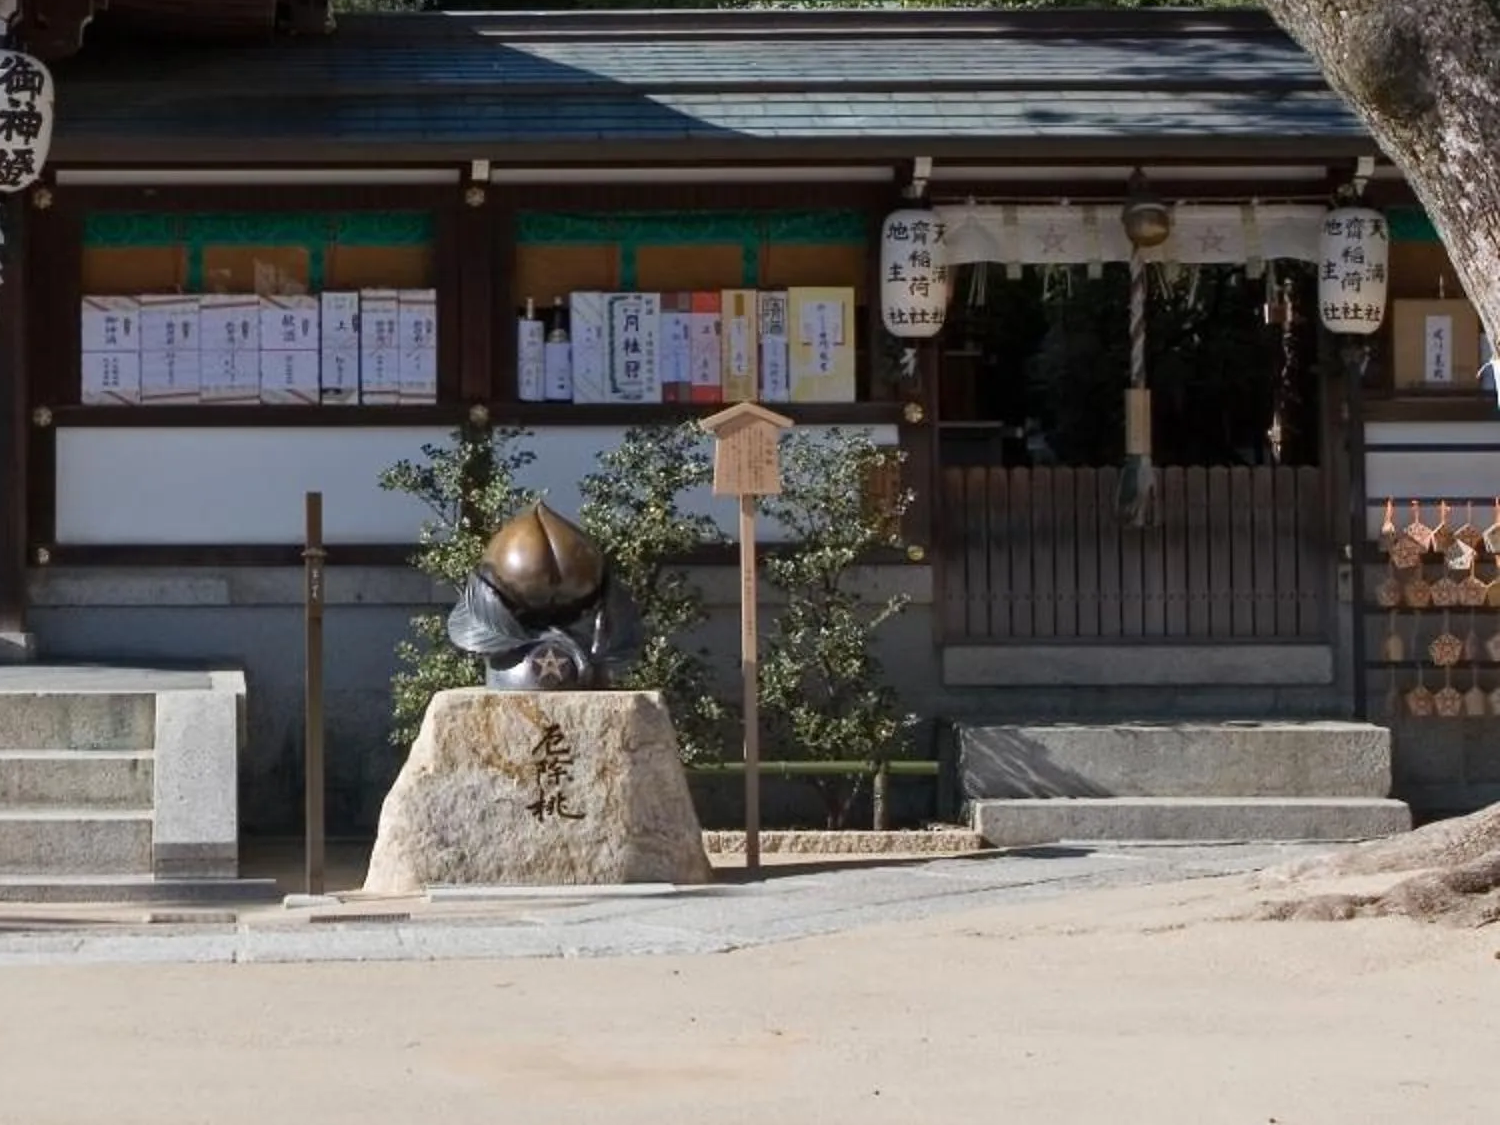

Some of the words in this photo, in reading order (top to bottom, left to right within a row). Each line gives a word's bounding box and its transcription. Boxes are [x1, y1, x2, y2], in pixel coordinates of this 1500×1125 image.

[886, 222, 909, 324] 地主社
[1322, 218, 1342, 320] 地主社
[1365, 218, 1386, 322] 天満社
[526, 724, 586, 822] 厄除桃
